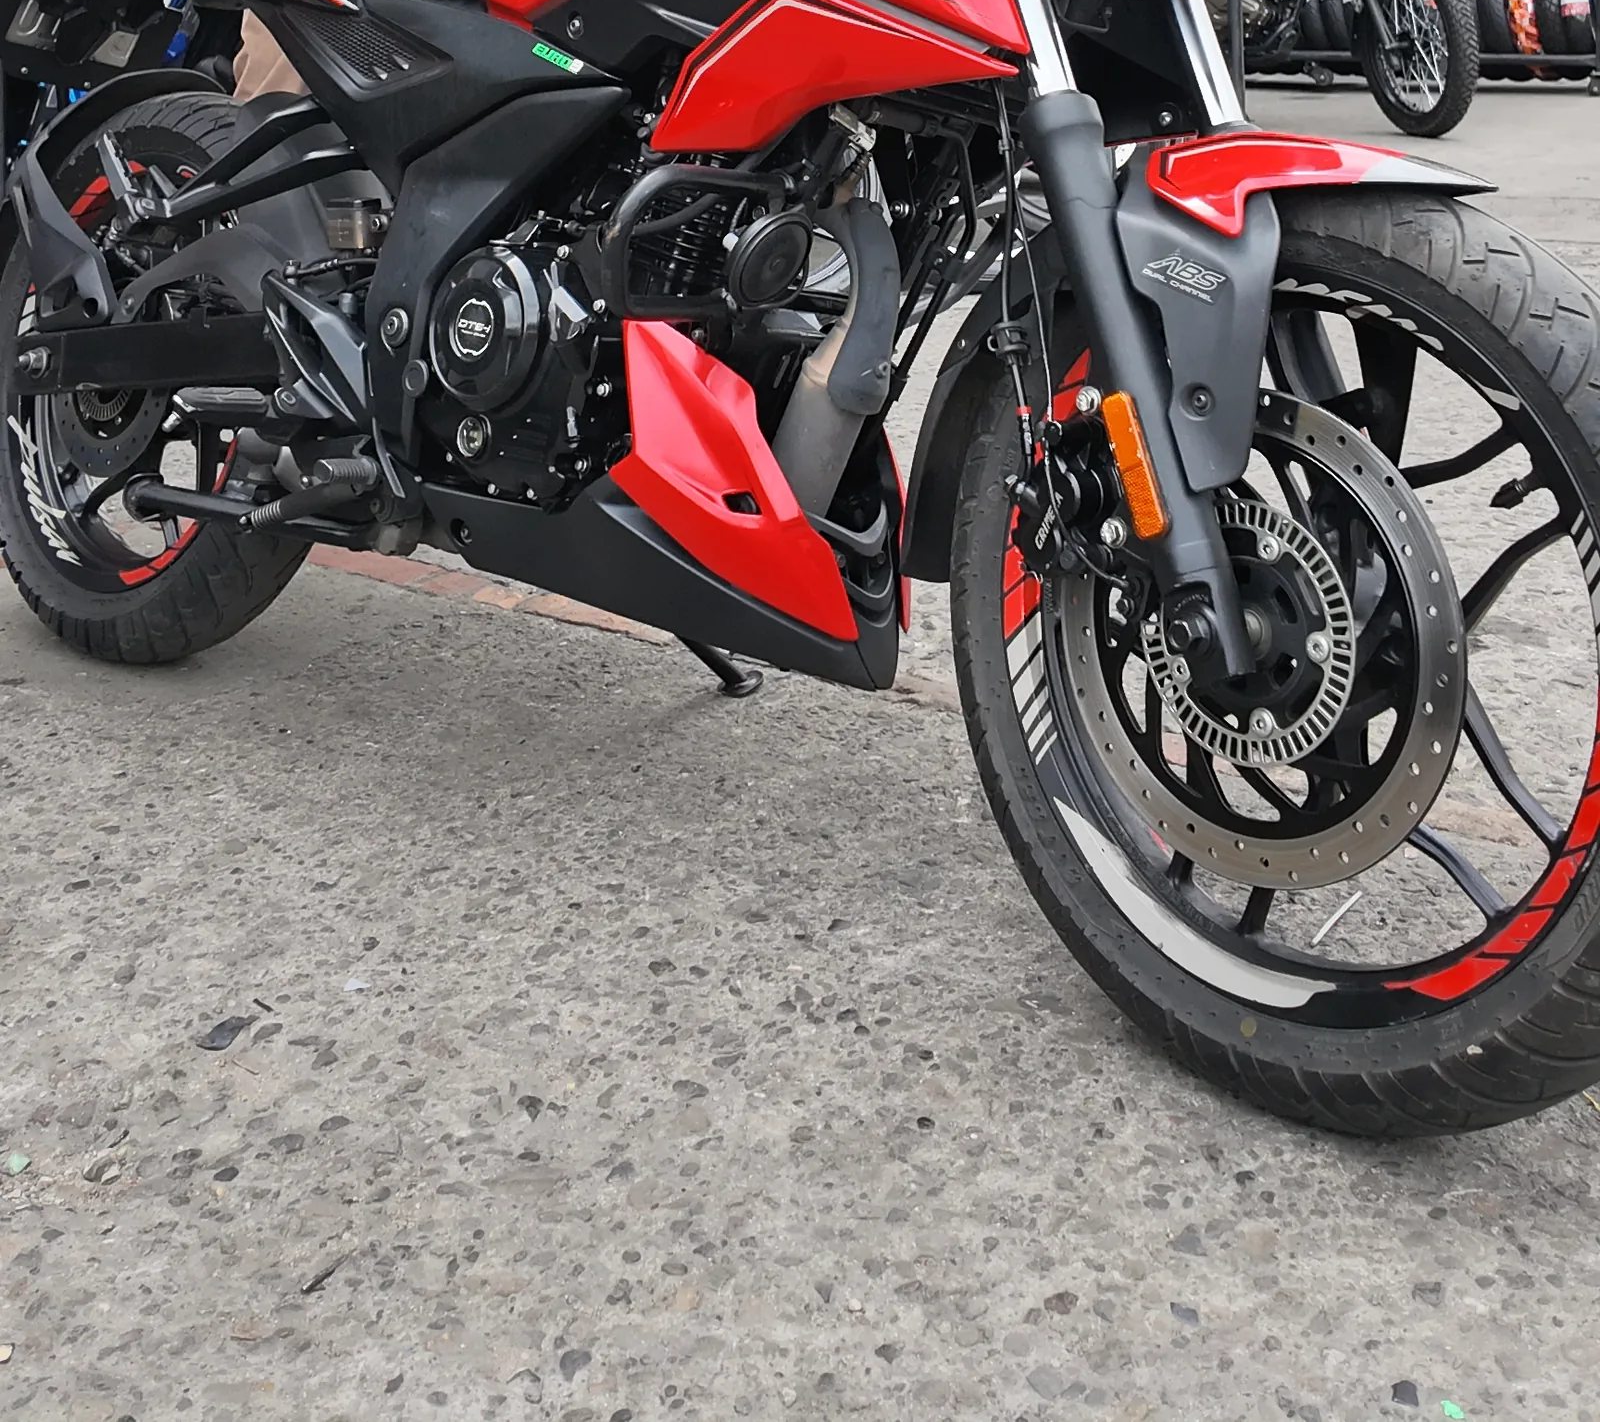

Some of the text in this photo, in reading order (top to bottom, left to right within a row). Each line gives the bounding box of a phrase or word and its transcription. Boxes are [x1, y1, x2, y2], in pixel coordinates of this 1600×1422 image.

[532, 43, 573, 70] EURO
[1142, 267, 1214, 303] DUAL CHANNEL
[1147, 256, 1227, 291] ABS
[1034, 491, 1064, 550] GRIMEA
